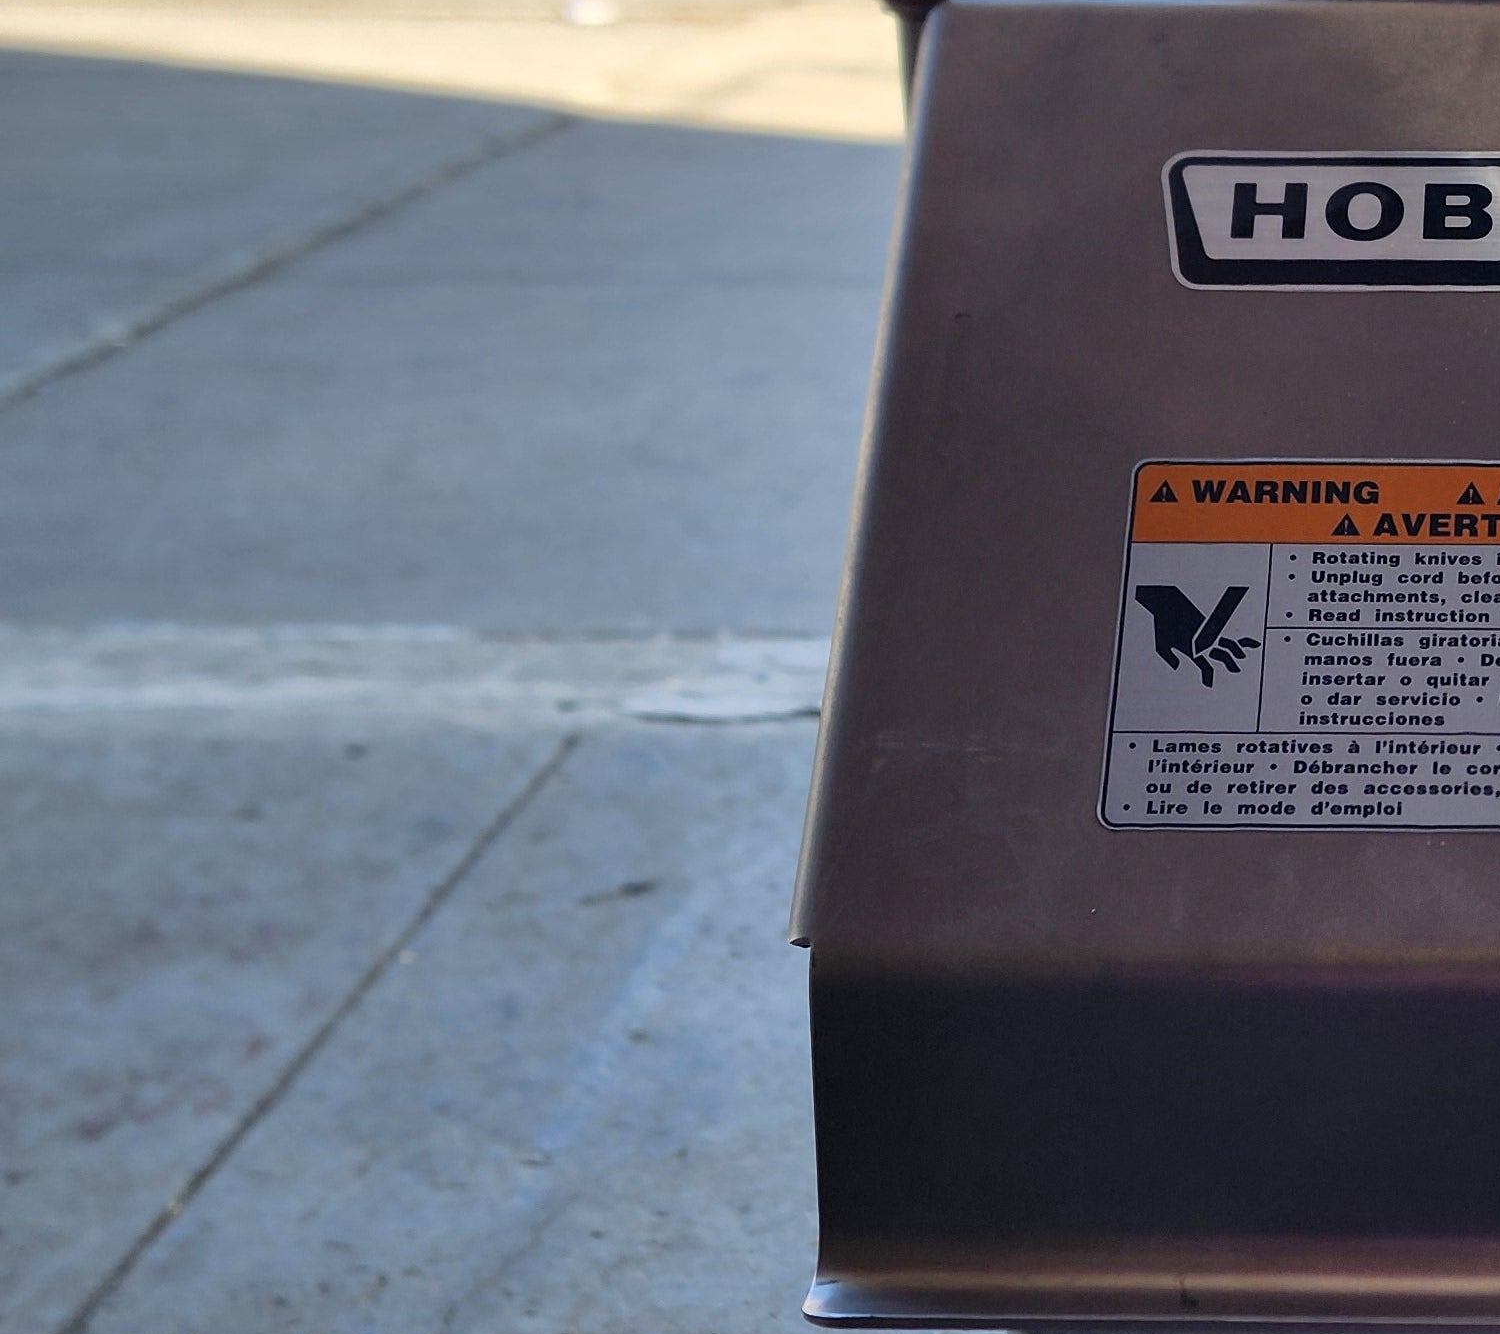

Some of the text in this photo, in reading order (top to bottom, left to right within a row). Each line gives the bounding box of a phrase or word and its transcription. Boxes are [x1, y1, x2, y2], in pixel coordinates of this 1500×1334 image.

[1192, 480, 1379, 504] WARNING
[1313, 552, 1400, 567] Rotating
[1415, 552, 1481, 565] knives
[1312, 571, 1382, 586] Unplug
[1398, 572, 1443, 584] cord
[1307, 590, 1445, 606] attachments,
[1309, 609, 1360, 621] Read
[1376, 609, 1489, 622] instruction
[1307, 633, 1403, 646] Cuchillas
[1305, 656, 1372, 666] manos
[1387, 653, 1441, 666] fuera
[1302, 672, 1385, 685] insertar
[1400, 676, 1411, 685] o
[1427, 673, 1489, 689] quitar
[1301, 695, 1312, 705] o
[1328, 692, 1361, 705] dar
[1377, 692, 1460, 706] servicio
[1300, 712, 1444, 726] instrucciones
[1153, 740, 1221, 753] Lames
[1237, 740, 1332, 753] rotatives
[1348, 740, 1359, 753] à
[1294, 760, 1417, 774] Débrancher
[1433, 761, 1451, 774] le
[1146, 784, 1171, 793] ou
[1187, 780, 1212, 793] de
[1227, 780, 1296, 794] retirer
[1311, 781, 1348, 794] des
[1364, 781, 1500, 798] accessories,
[1147, 800, 1188, 814] Lire
[1204, 801, 1222, 814] le
[1238, 801, 1295, 814] mode
